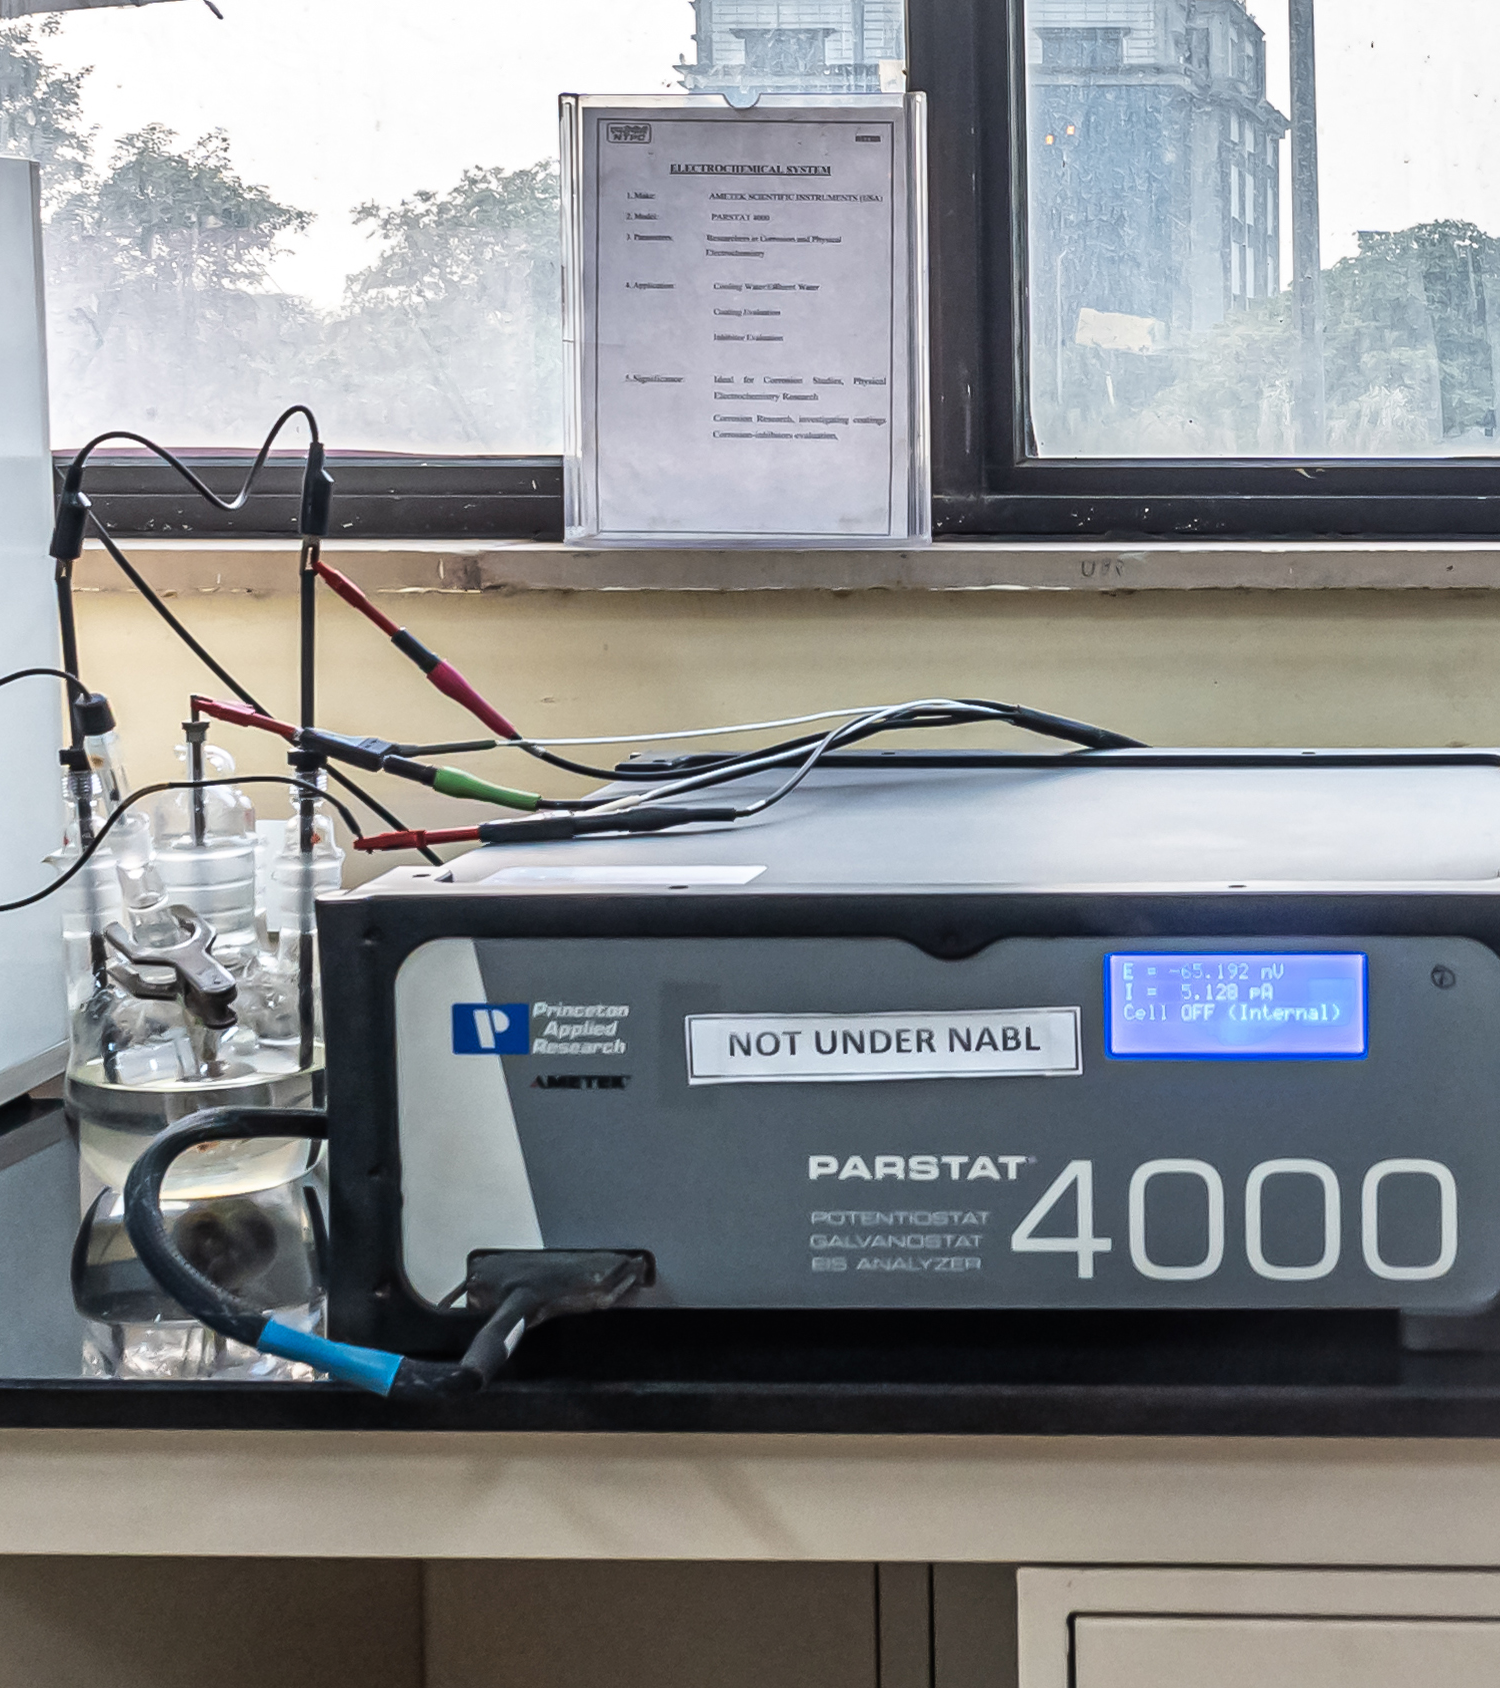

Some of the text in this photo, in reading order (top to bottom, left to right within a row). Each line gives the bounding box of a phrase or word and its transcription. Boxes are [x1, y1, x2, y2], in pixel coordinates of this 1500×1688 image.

[670, 164, 831, 176] ELECTROCHEMICAL SYSTEM
[748, 193, 794, 201] SCIENTIFIC
[795, 194, 859, 202] INSTRUMENTS
[714, 376, 734, 384] Ideal
[744, 376, 754, 384] for
[853, 377, 887, 387] Physical
[1123, 963, 1134, 980] E
[1125, 983, 1133, 1001] I
[533, 1002, 629, 1018] Princeton
[1124, 1004, 1341, 1021] Cell OFF (Internal)
[543, 1021, 619, 1039] Applied
[532, 1039, 627, 1055] Research
[729, 1025, 1041, 1056] NOT UNDER NABL
[808, 1155, 1459, 1281] PARSTAT 4000
[811, 1212, 990, 1226] POTENTIOSTAT
[810, 1235, 983, 1249] GALVANOSTAT
[812, 1257, 982, 1271] EIS ANALYZER
